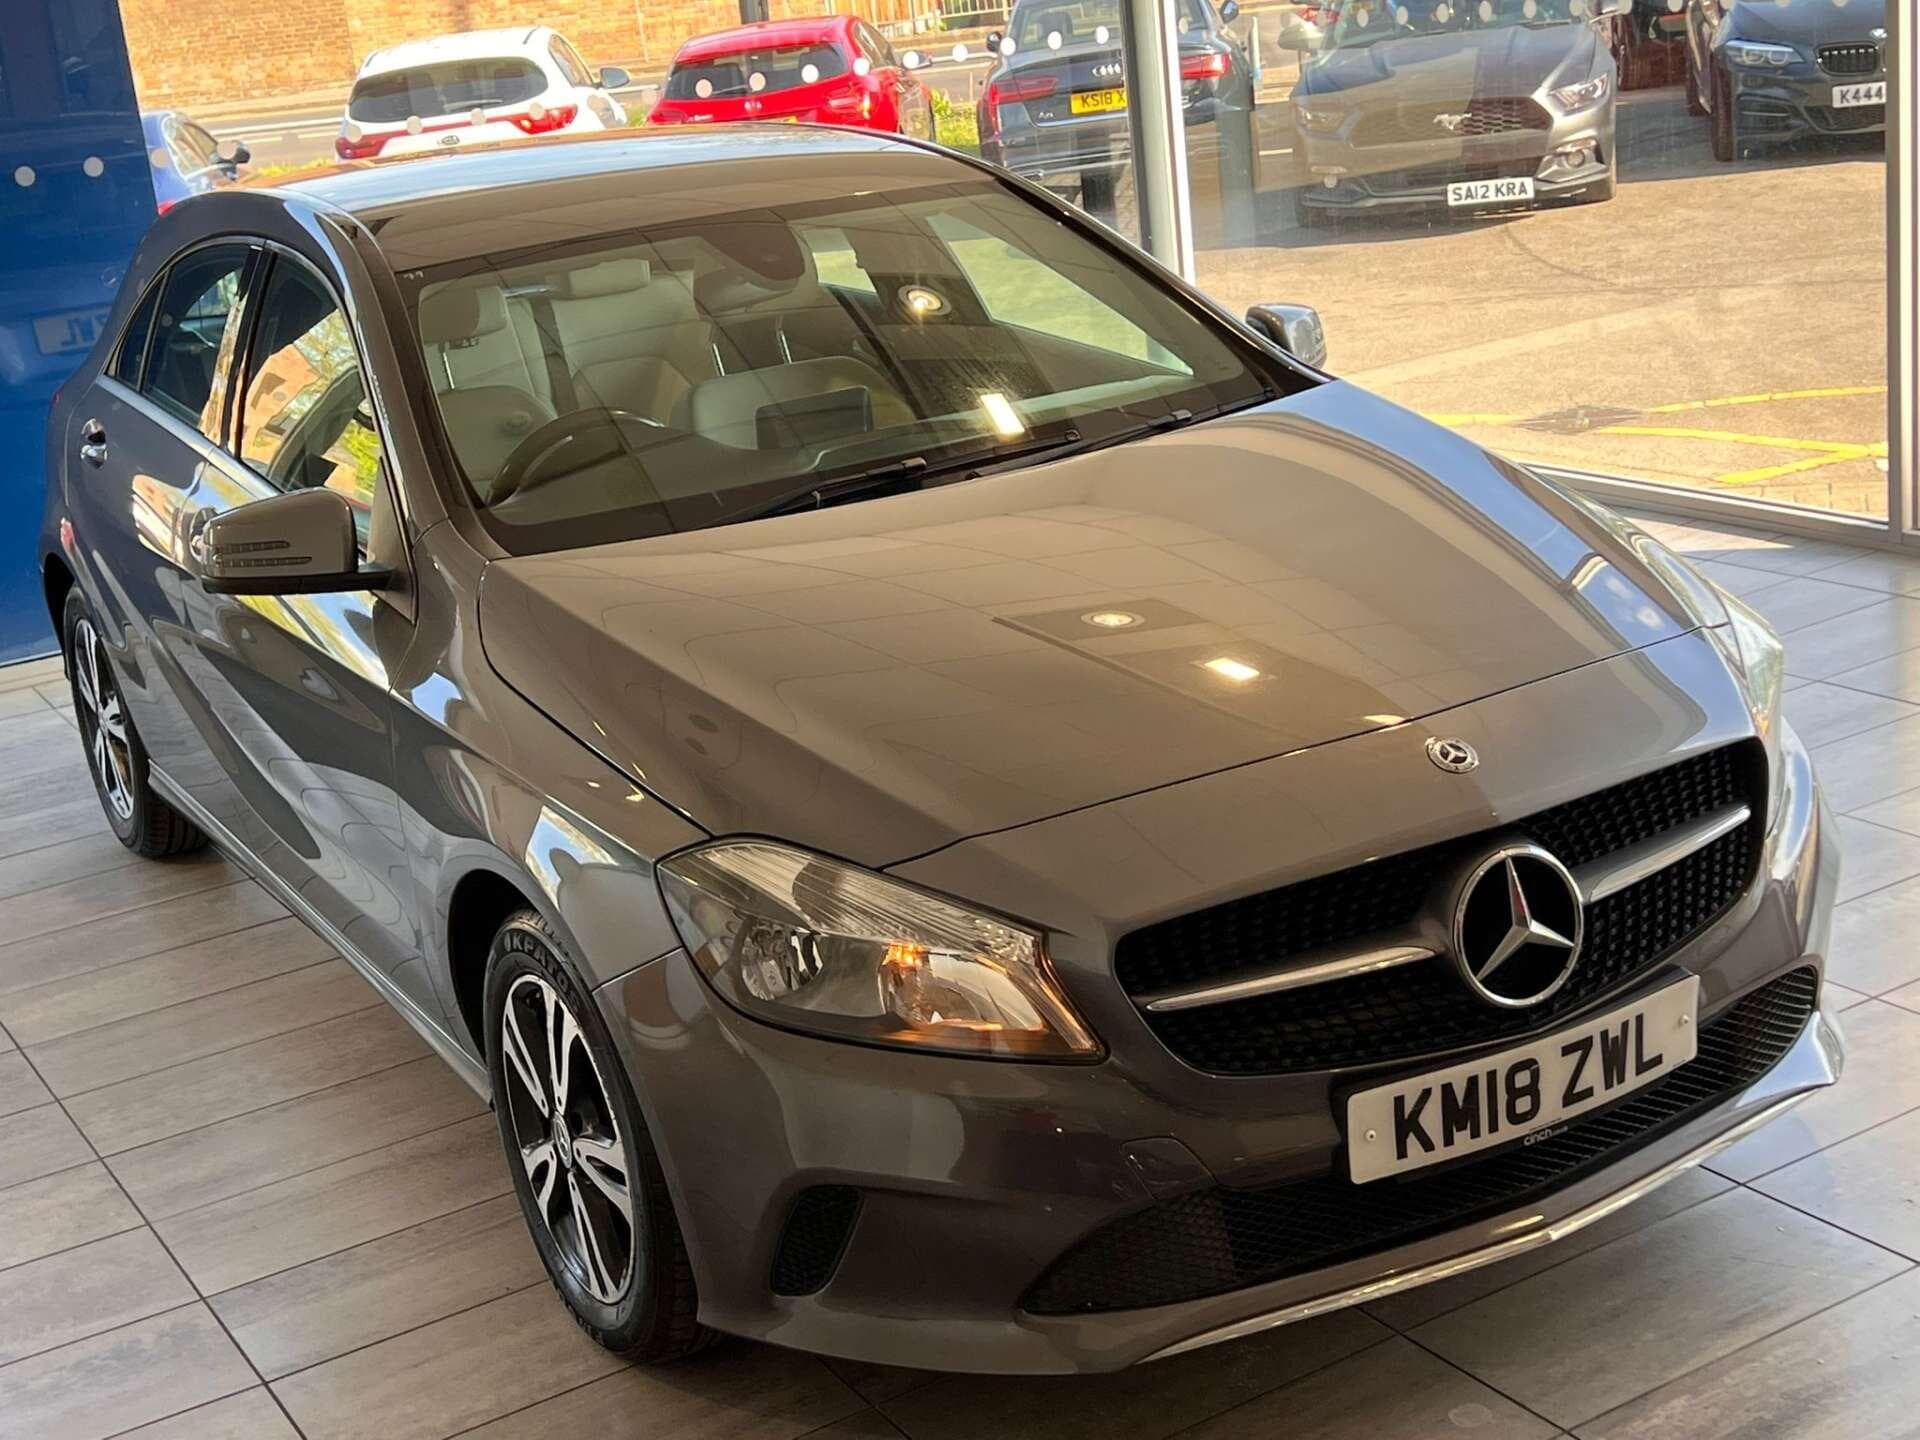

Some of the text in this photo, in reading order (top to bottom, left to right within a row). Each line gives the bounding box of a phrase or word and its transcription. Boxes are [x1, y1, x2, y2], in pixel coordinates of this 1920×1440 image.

[1080, 91, 1113, 108] KS18
[1839, 86, 1883, 104] K444
[1452, 181, 1528, 201] SA12 KRA
[1393, 1013, 1664, 1160] KM18 ZWL
